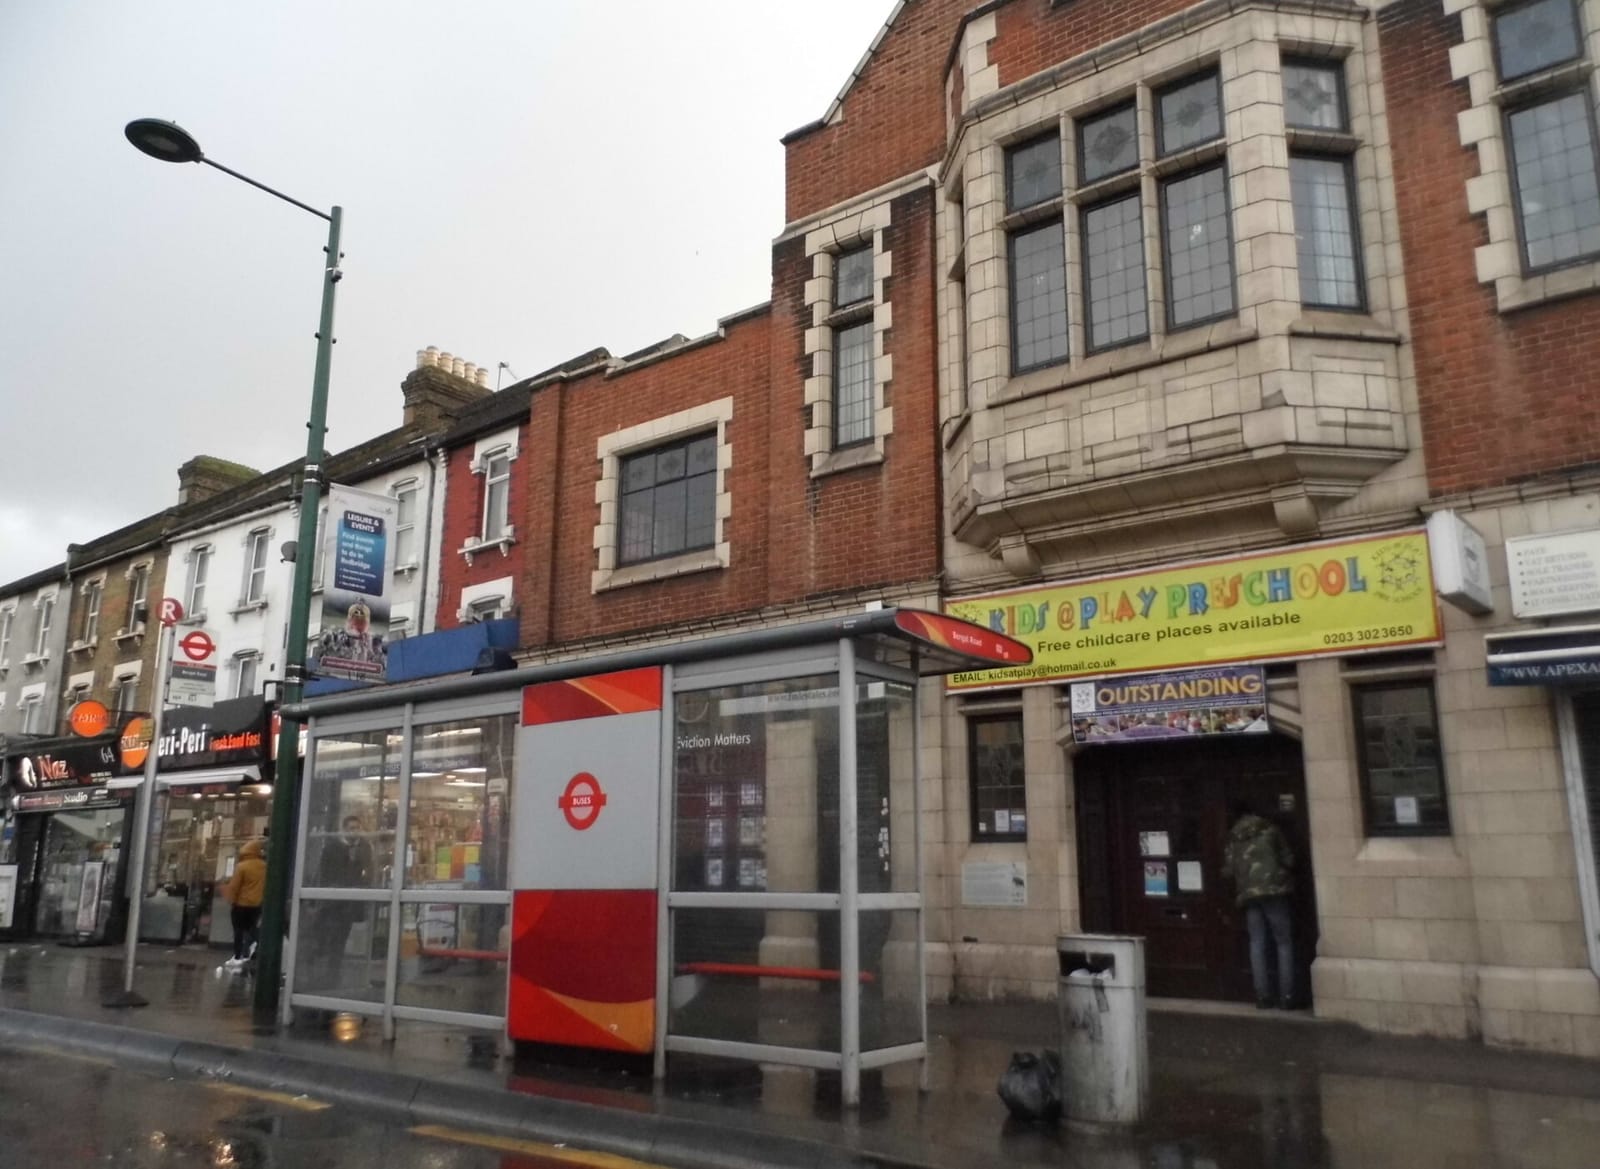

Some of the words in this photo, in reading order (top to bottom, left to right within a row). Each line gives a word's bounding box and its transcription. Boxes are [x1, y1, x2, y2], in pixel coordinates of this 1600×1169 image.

[347, 513, 373, 525] LEISURE
[373, 519, 380, 527] &
[351, 522, 375, 533] EVENTS
[989, 601, 1050, 635] KIDS
[1057, 601, 1075, 631] @
[1079, 586, 1158, 630] PLAY
[1165, 556, 1367, 620] PRESCHOOL
[161, 601, 176, 620] R
[1037, 640, 1072, 653] Free
[1076, 628, 1151, 649] childcare
[1156, 621, 1213, 643] places
[1218, 612, 1302, 633] available
[1323, 631, 1354, 645] 0203
[1357, 628, 1380, 641] 302
[1382, 625, 1413, 638] 3650
[953, 672, 987, 683] EMAIL:
[988, 658, 1117, 680] kidsatplay@hotmail.co.uk
[1097, 674, 1262, 706] OUTSTANDING
[714, 732, 752, 747] Matters
[101, 746, 115, 763] 64
[37, 754, 69, 780] Naz
[573, 796, 591, 806] BUSES
